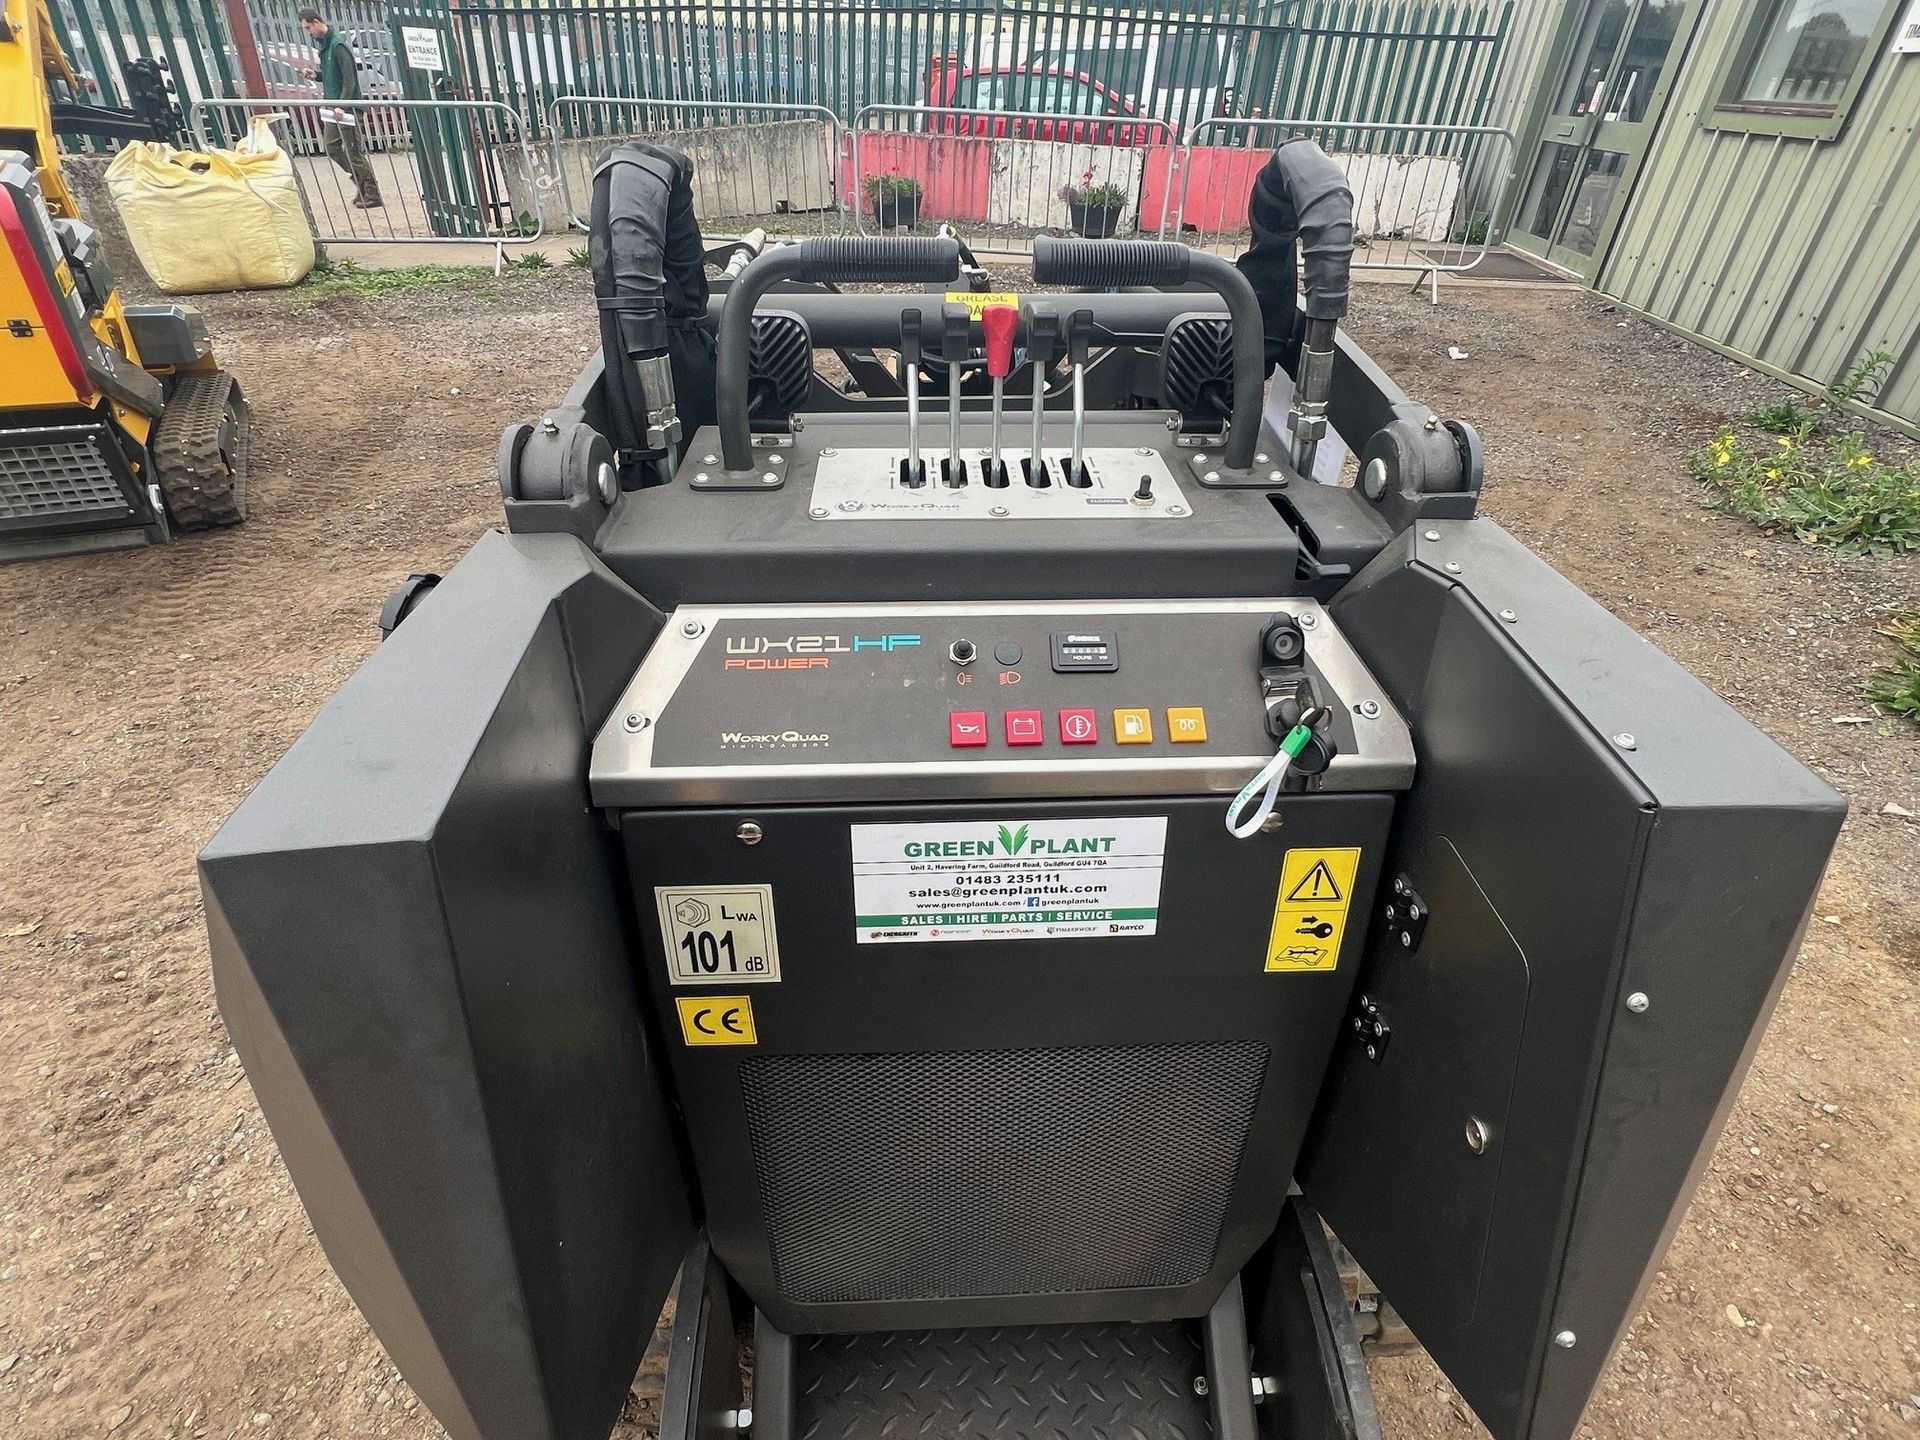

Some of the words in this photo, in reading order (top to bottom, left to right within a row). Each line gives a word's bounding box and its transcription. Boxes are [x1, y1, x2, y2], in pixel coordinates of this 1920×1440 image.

[408, 45, 438, 56] ENTRANCE
[956, 294, 1008, 302] GREASE
[724, 657, 830, 671] POWER
[904, 841, 994, 857] GREEN
[1030, 837, 1116, 854] PLANT
[935, 863, 966, 871] Havering
[956, 875, 1001, 885] 01483
[1007, 873, 1060, 884] 235111
[908, 884, 1107, 898] sales@greenplantuk.com
[916, 900, 1021, 909] www.greenplantuk.com
[1041, 898, 1100, 907] greenplantuk
[901, 915, 943, 925] SALES
[956, 914, 988, 924] HIRE
[1001, 912, 1043, 922] PARTS
[1056, 911, 1113, 921] SERVICE
[682, 930, 737, 973] 101
[745, 956, 764, 972] dB
[693, 1008, 743, 1034] CE
